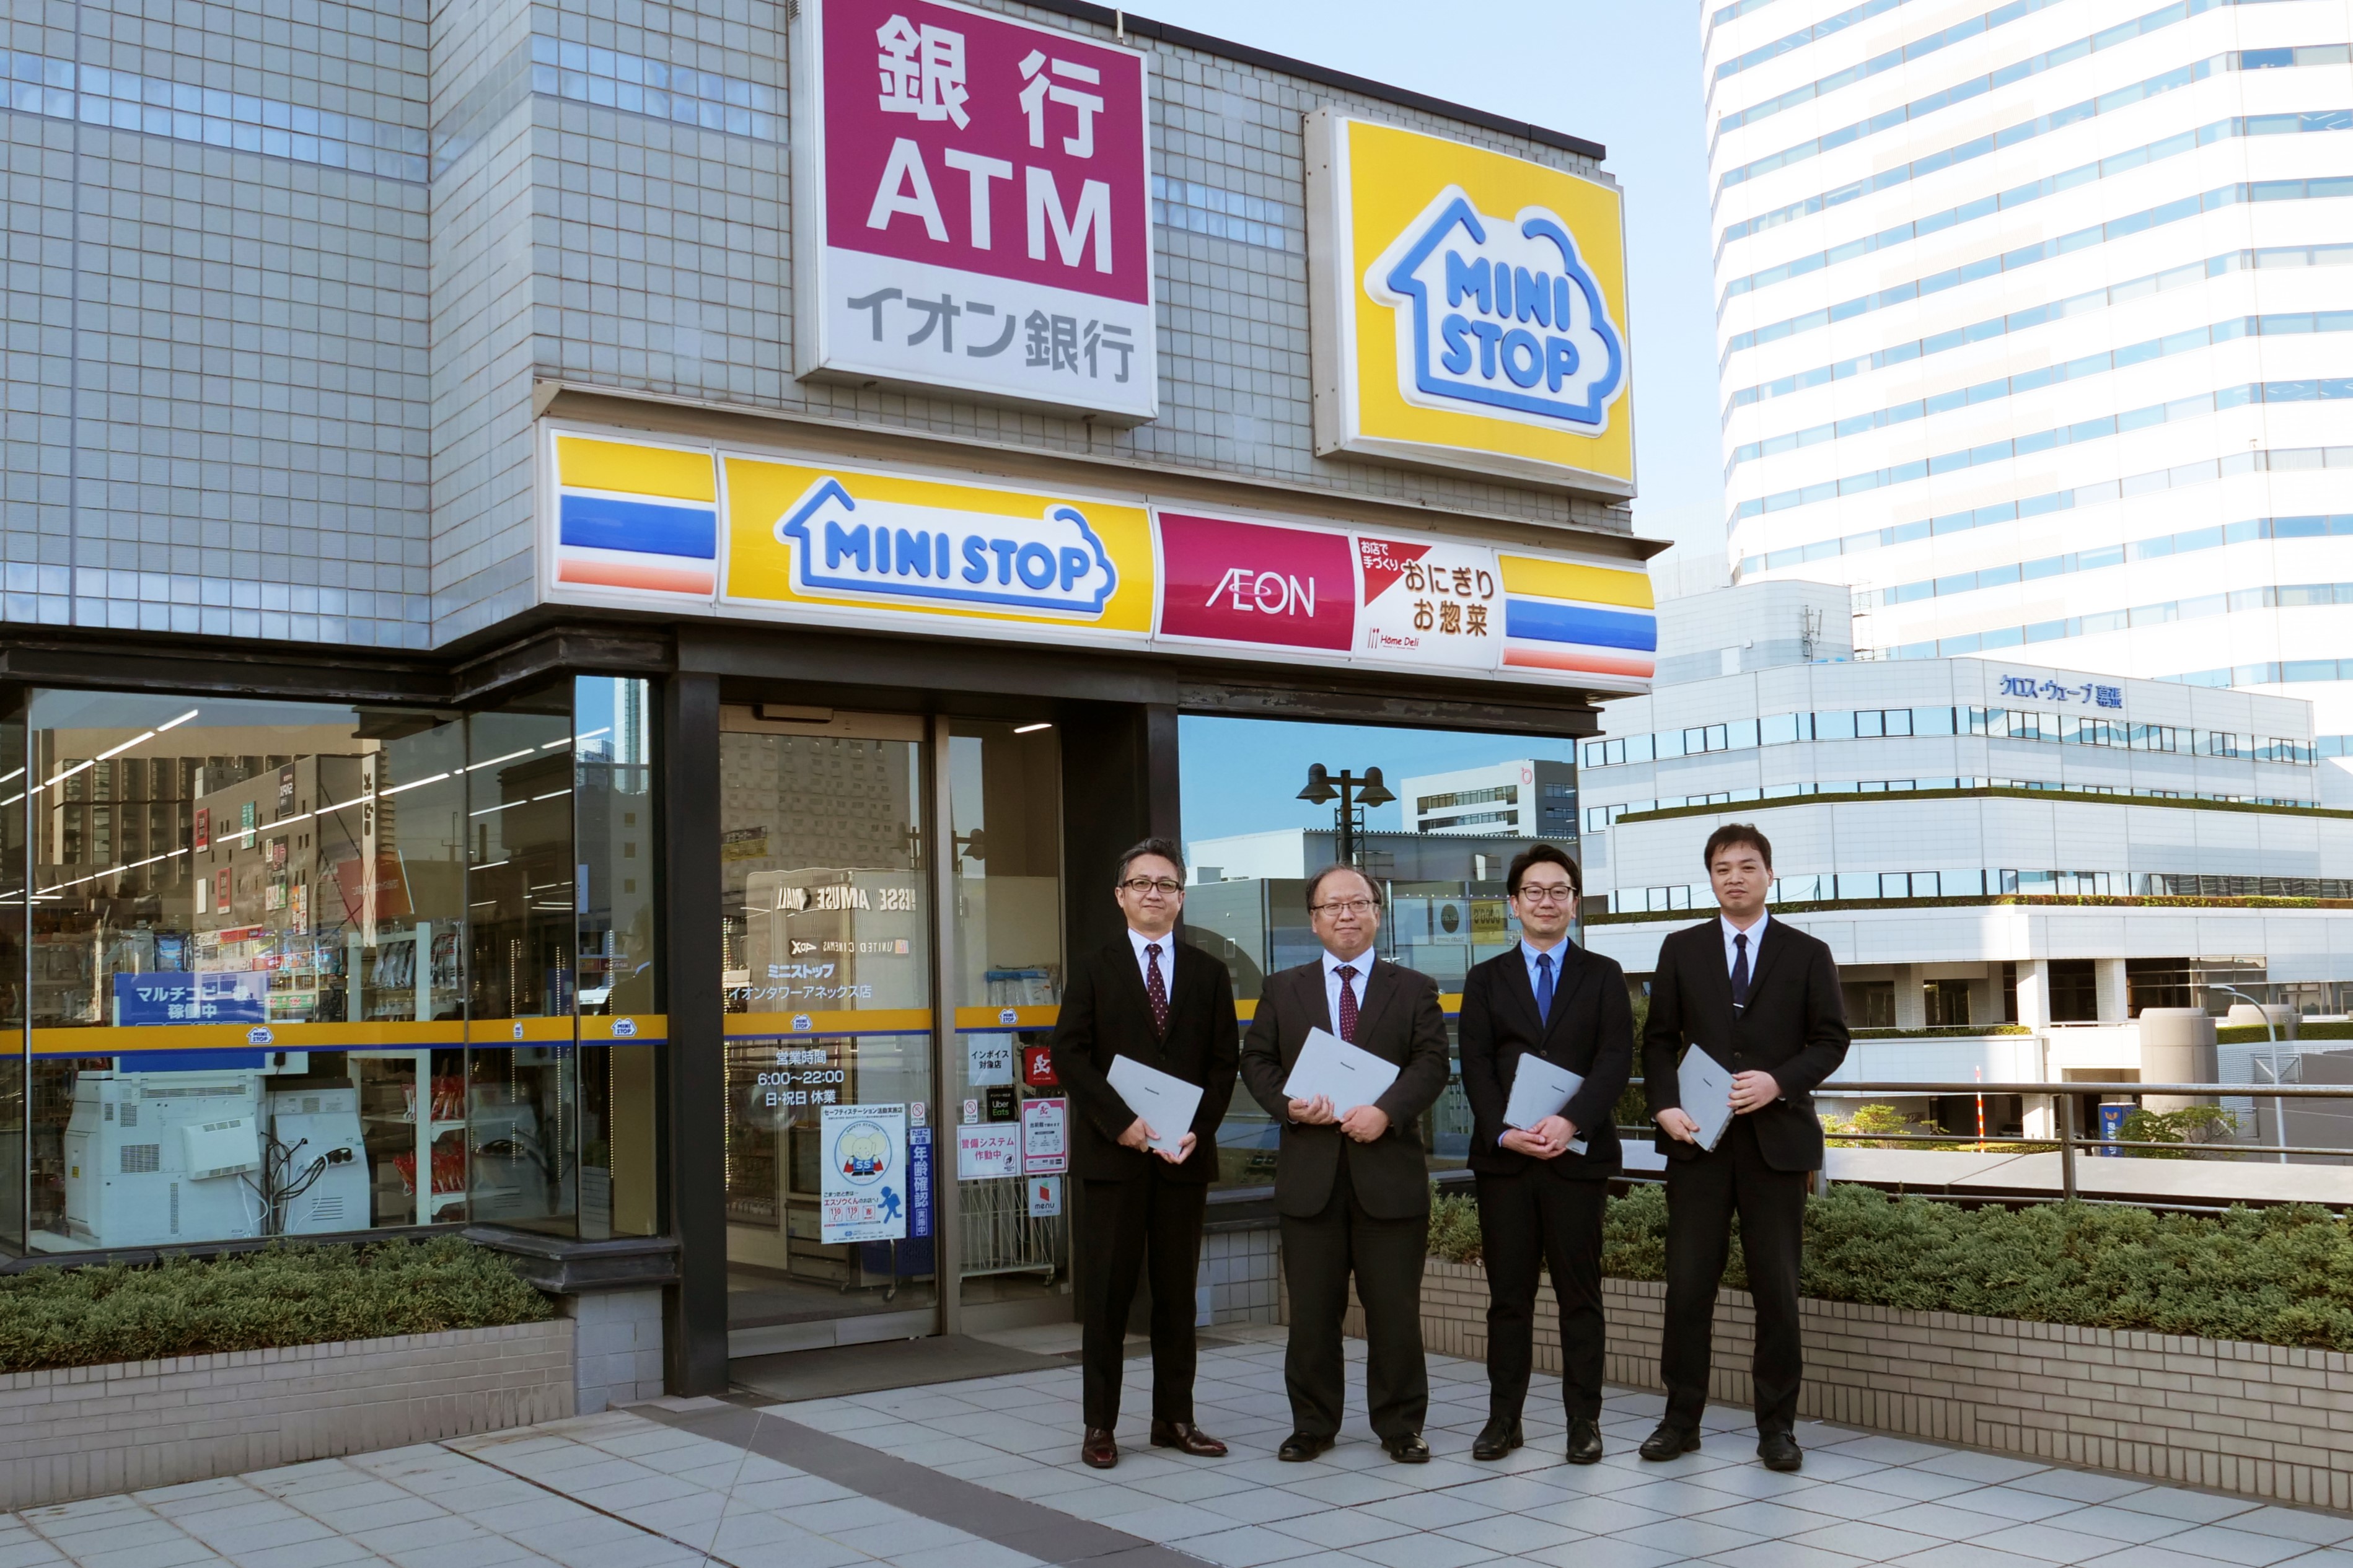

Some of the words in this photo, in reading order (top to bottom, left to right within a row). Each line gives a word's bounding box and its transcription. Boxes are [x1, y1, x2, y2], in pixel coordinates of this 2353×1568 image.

[876, 14, 1104, 159] 銀行
[866, 136, 1113, 274] ATM
[1445, 249, 1571, 331] MINI
[847, 287, 1134, 383] イオン銀行
[1441, 313, 1580, 392] STOP
[824, 520, 949, 580] MINI
[961, 534, 1091, 592] STOP
[1361, 541, 1388, 556] お店で
[1363, 556, 1399, 571] 手づくり
[1403, 561, 1494, 600] おにぎり
[1413, 598, 1487, 637] お惣菜
[1404, 637, 1419, 647] Deli
[768, 963, 835, 979] ミニストップ
[728, 985, 872, 1001] イオンタワーアネックス店
[776, 1050, 826, 1066] 営業時間
[971, 1050, 1009, 1059] インボイス
[979, 1060, 1001, 1069] 対象店
[811, 1089, 836, 1104] 休業
[962, 1137, 1014, 1149] 警備システム
[975, 1150, 1001, 1161] 作動中
[856, 1161, 871, 1169] SS
[913, 1146, 928, 1208] 年齢確認
